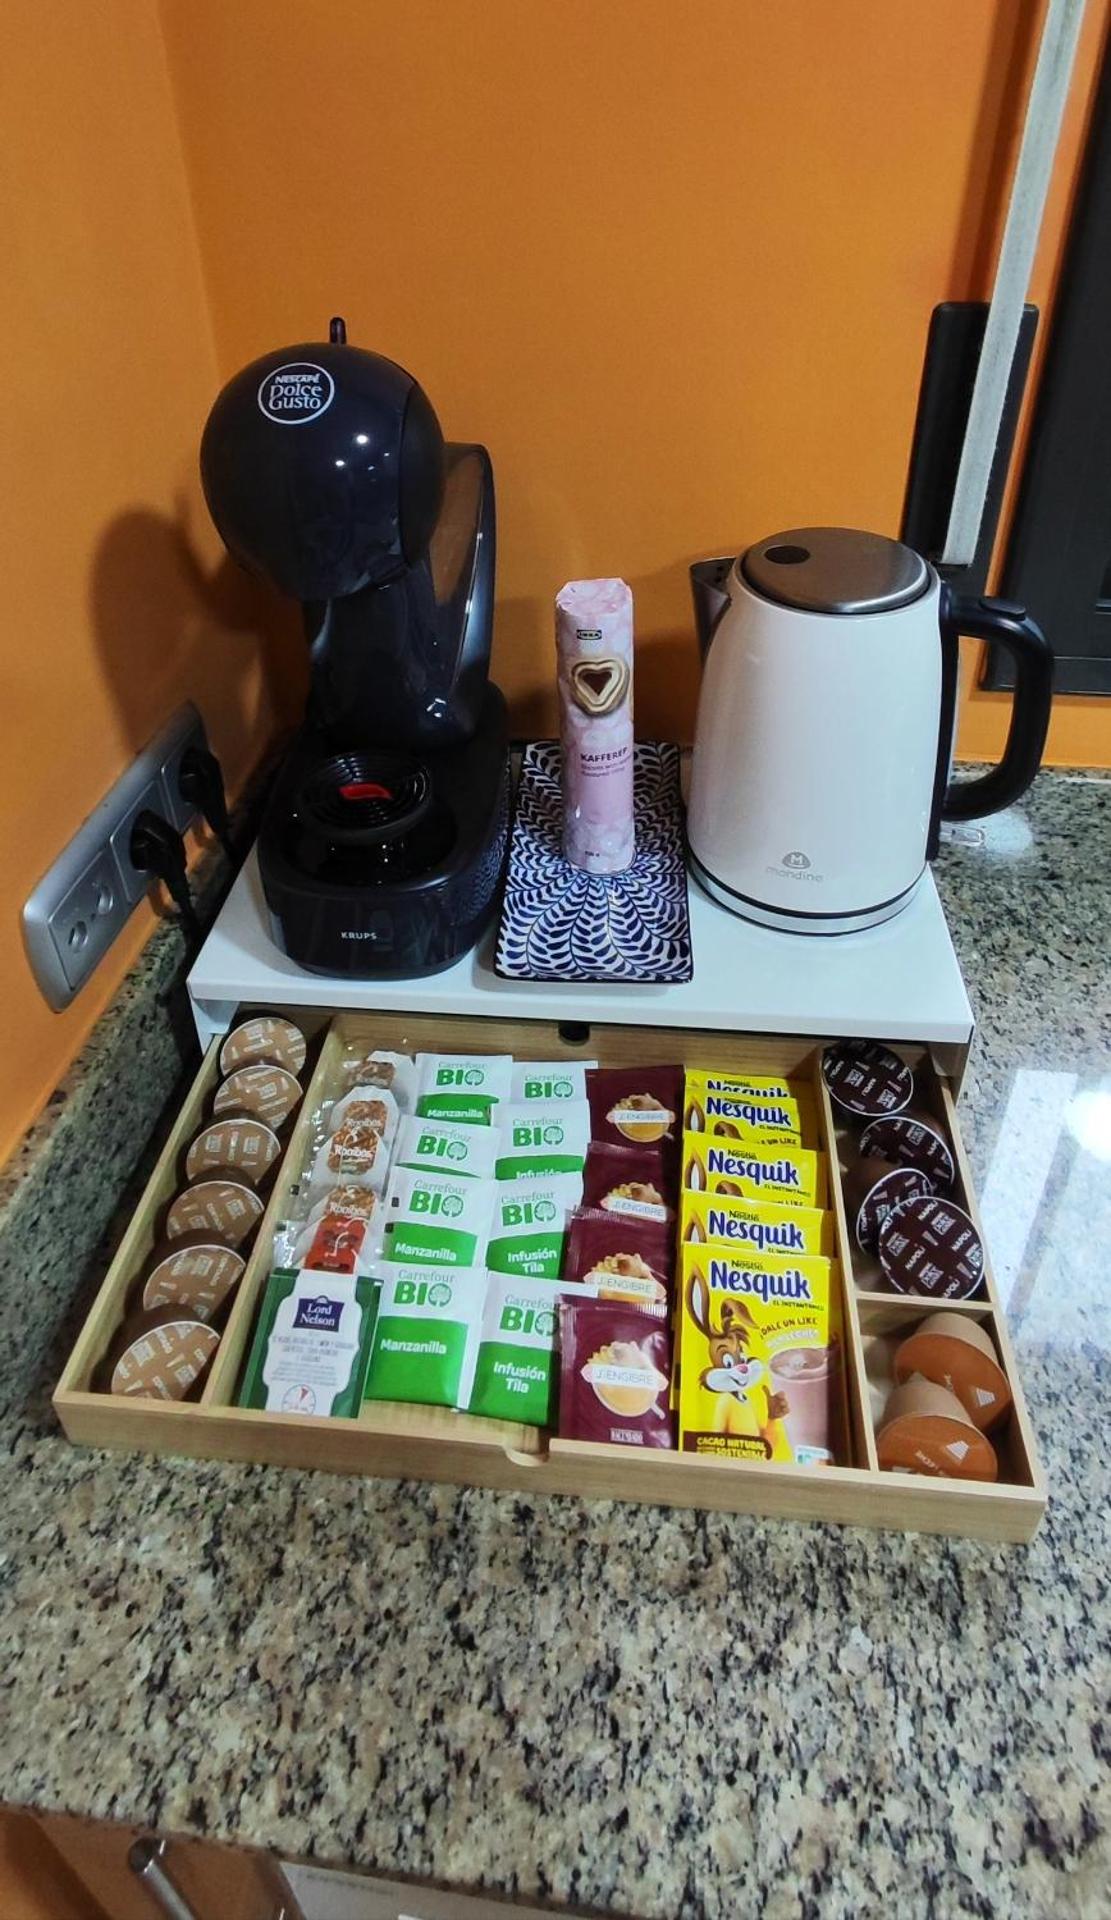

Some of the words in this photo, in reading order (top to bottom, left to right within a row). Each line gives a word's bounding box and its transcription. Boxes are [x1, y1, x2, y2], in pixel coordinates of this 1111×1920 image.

[274, 373, 320, 384] NESCAFÉ
[270, 383, 323, 397] Dolce
[269, 397, 322, 410] Gusto
[341, 931, 377, 940] KRUPS
[436, 1069, 485, 1086] BIO
[524, 1081, 574, 1098] BIO
[427, 1108, 484, 1119] Manzanilla
[706, 1096, 792, 1127] Nesquik
[512, 1126, 564, 1147] BIO
[416, 1135, 468, 1161] BIO
[708, 1149, 799, 1186] Nesquik
[413, 1179, 468, 1194] Carrefour
[408, 1190, 464, 1218] BIO
[501, 1200, 556, 1227] BIO
[709, 1211, 804, 1249] Nesquik
[951, 1228, 972, 1251] NAPOLI
[395, 1242, 457, 1261] Manzanilla
[507, 1247, 558, 1264] Infusión
[905, 1246, 926, 1270] NAPOLI
[523, 1260, 545, 1273] Tila
[398, 1269, 456, 1283] Carrefour
[711, 1261, 811, 1302] Nesquik
[394, 1281, 452, 1308] BIO
[307, 1303, 333, 1315] Lord
[300, 1312, 335, 1326] Nelson
[380, 1339, 447, 1355] Manzanilla
[493, 1361, 546, 1382] Infusión
[505, 1378, 530, 1394] Tila
[696, 1437, 726, 1447] CACAO
